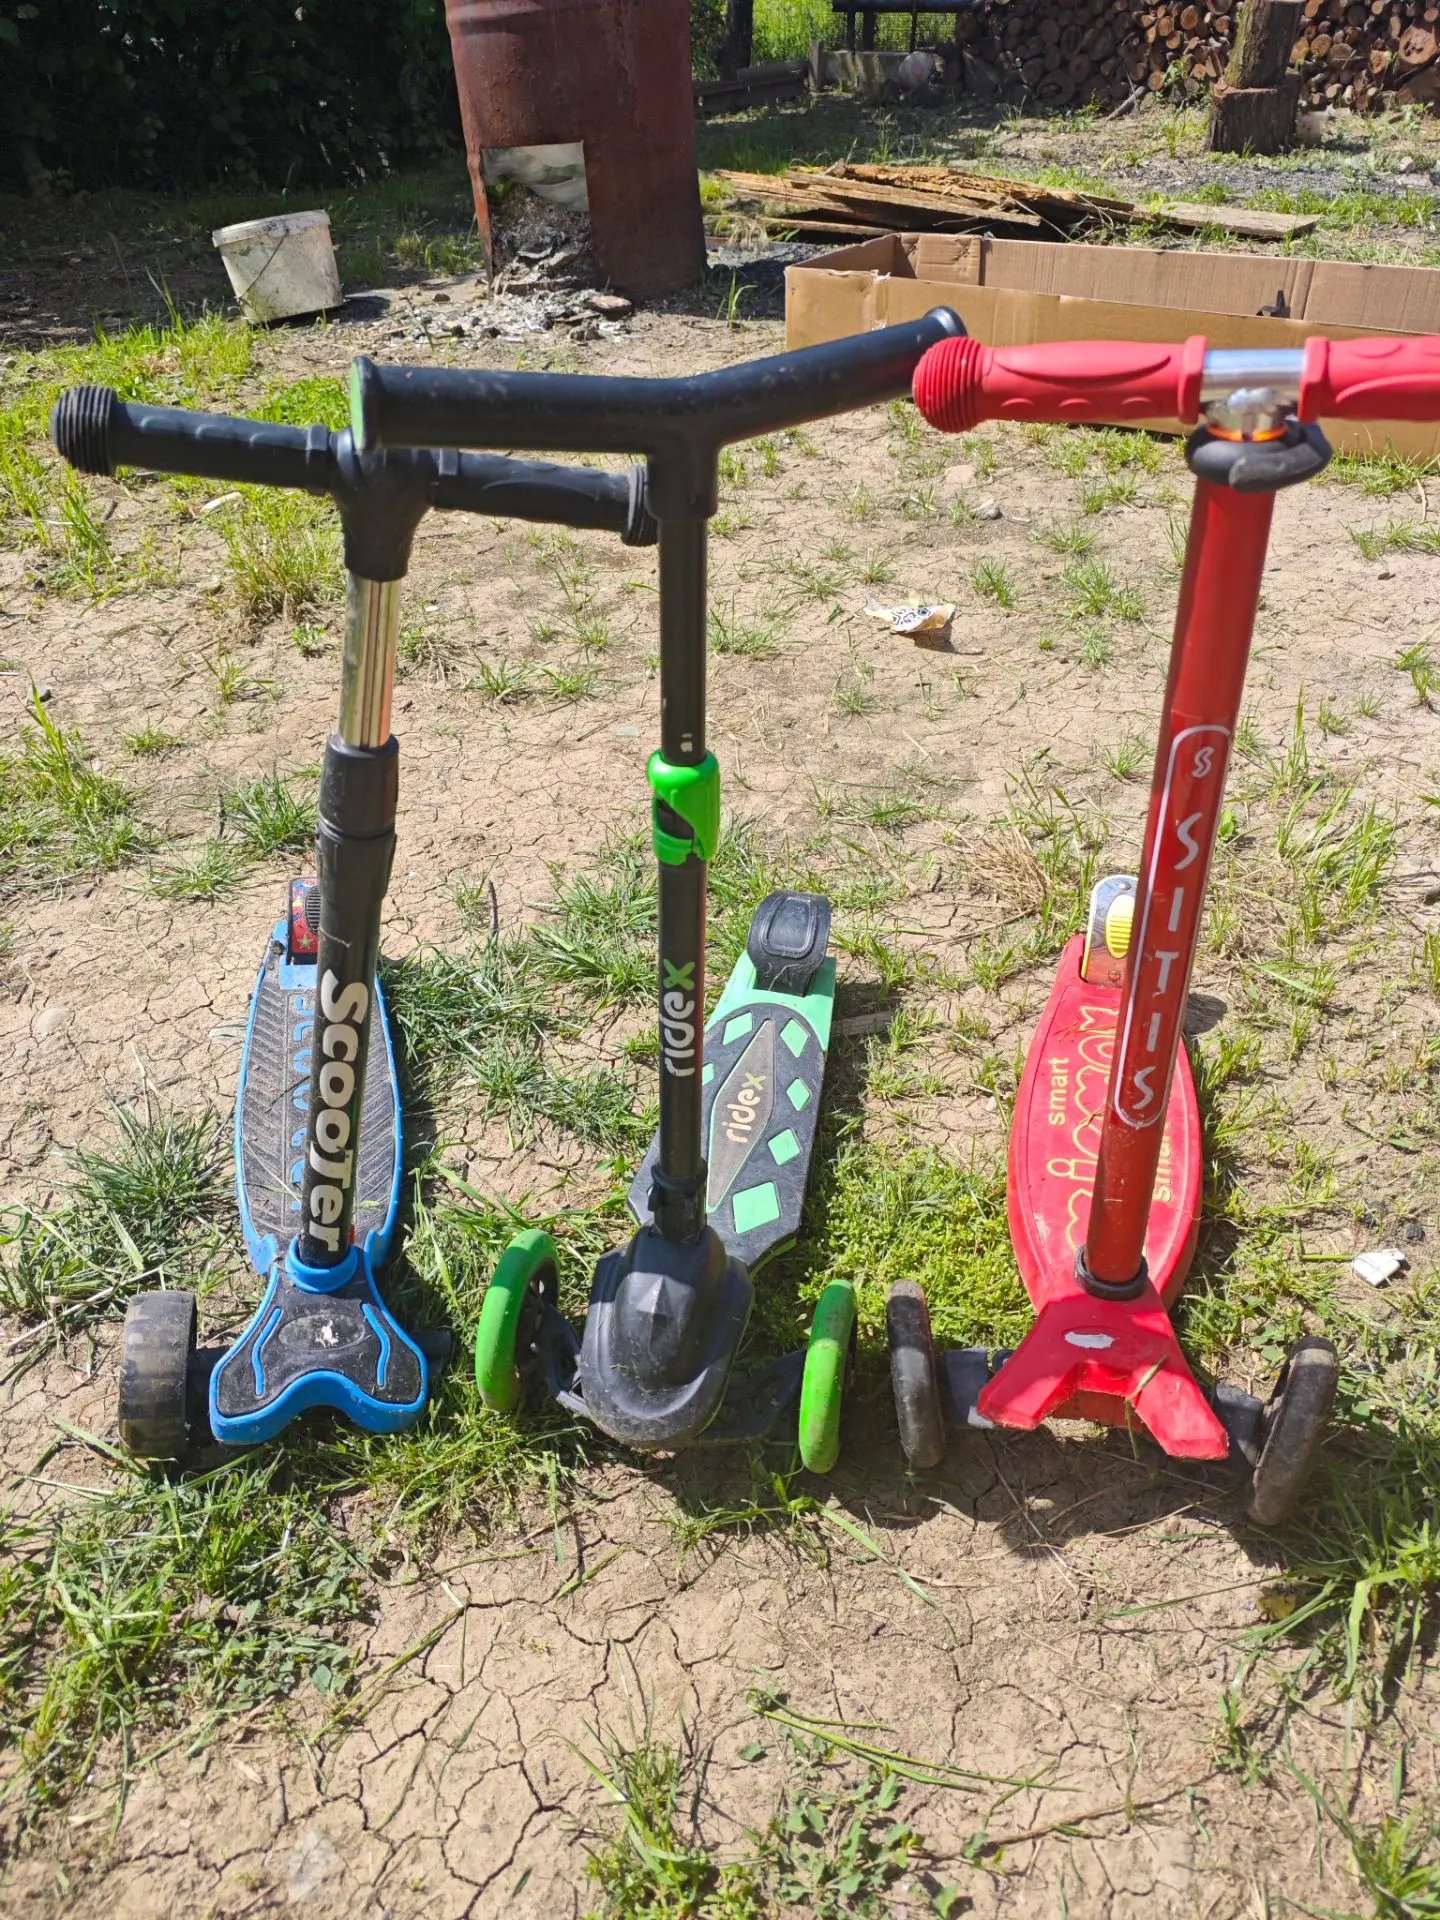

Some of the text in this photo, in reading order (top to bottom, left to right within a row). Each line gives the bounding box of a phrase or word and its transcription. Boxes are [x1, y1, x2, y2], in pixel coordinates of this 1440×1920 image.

[1132, 812, 1203, 1110] SITIS
[659, 958, 696, 1077] ridex
[722, 1073, 767, 1143] ridex
[1049, 1057, 1069, 1126] smart
